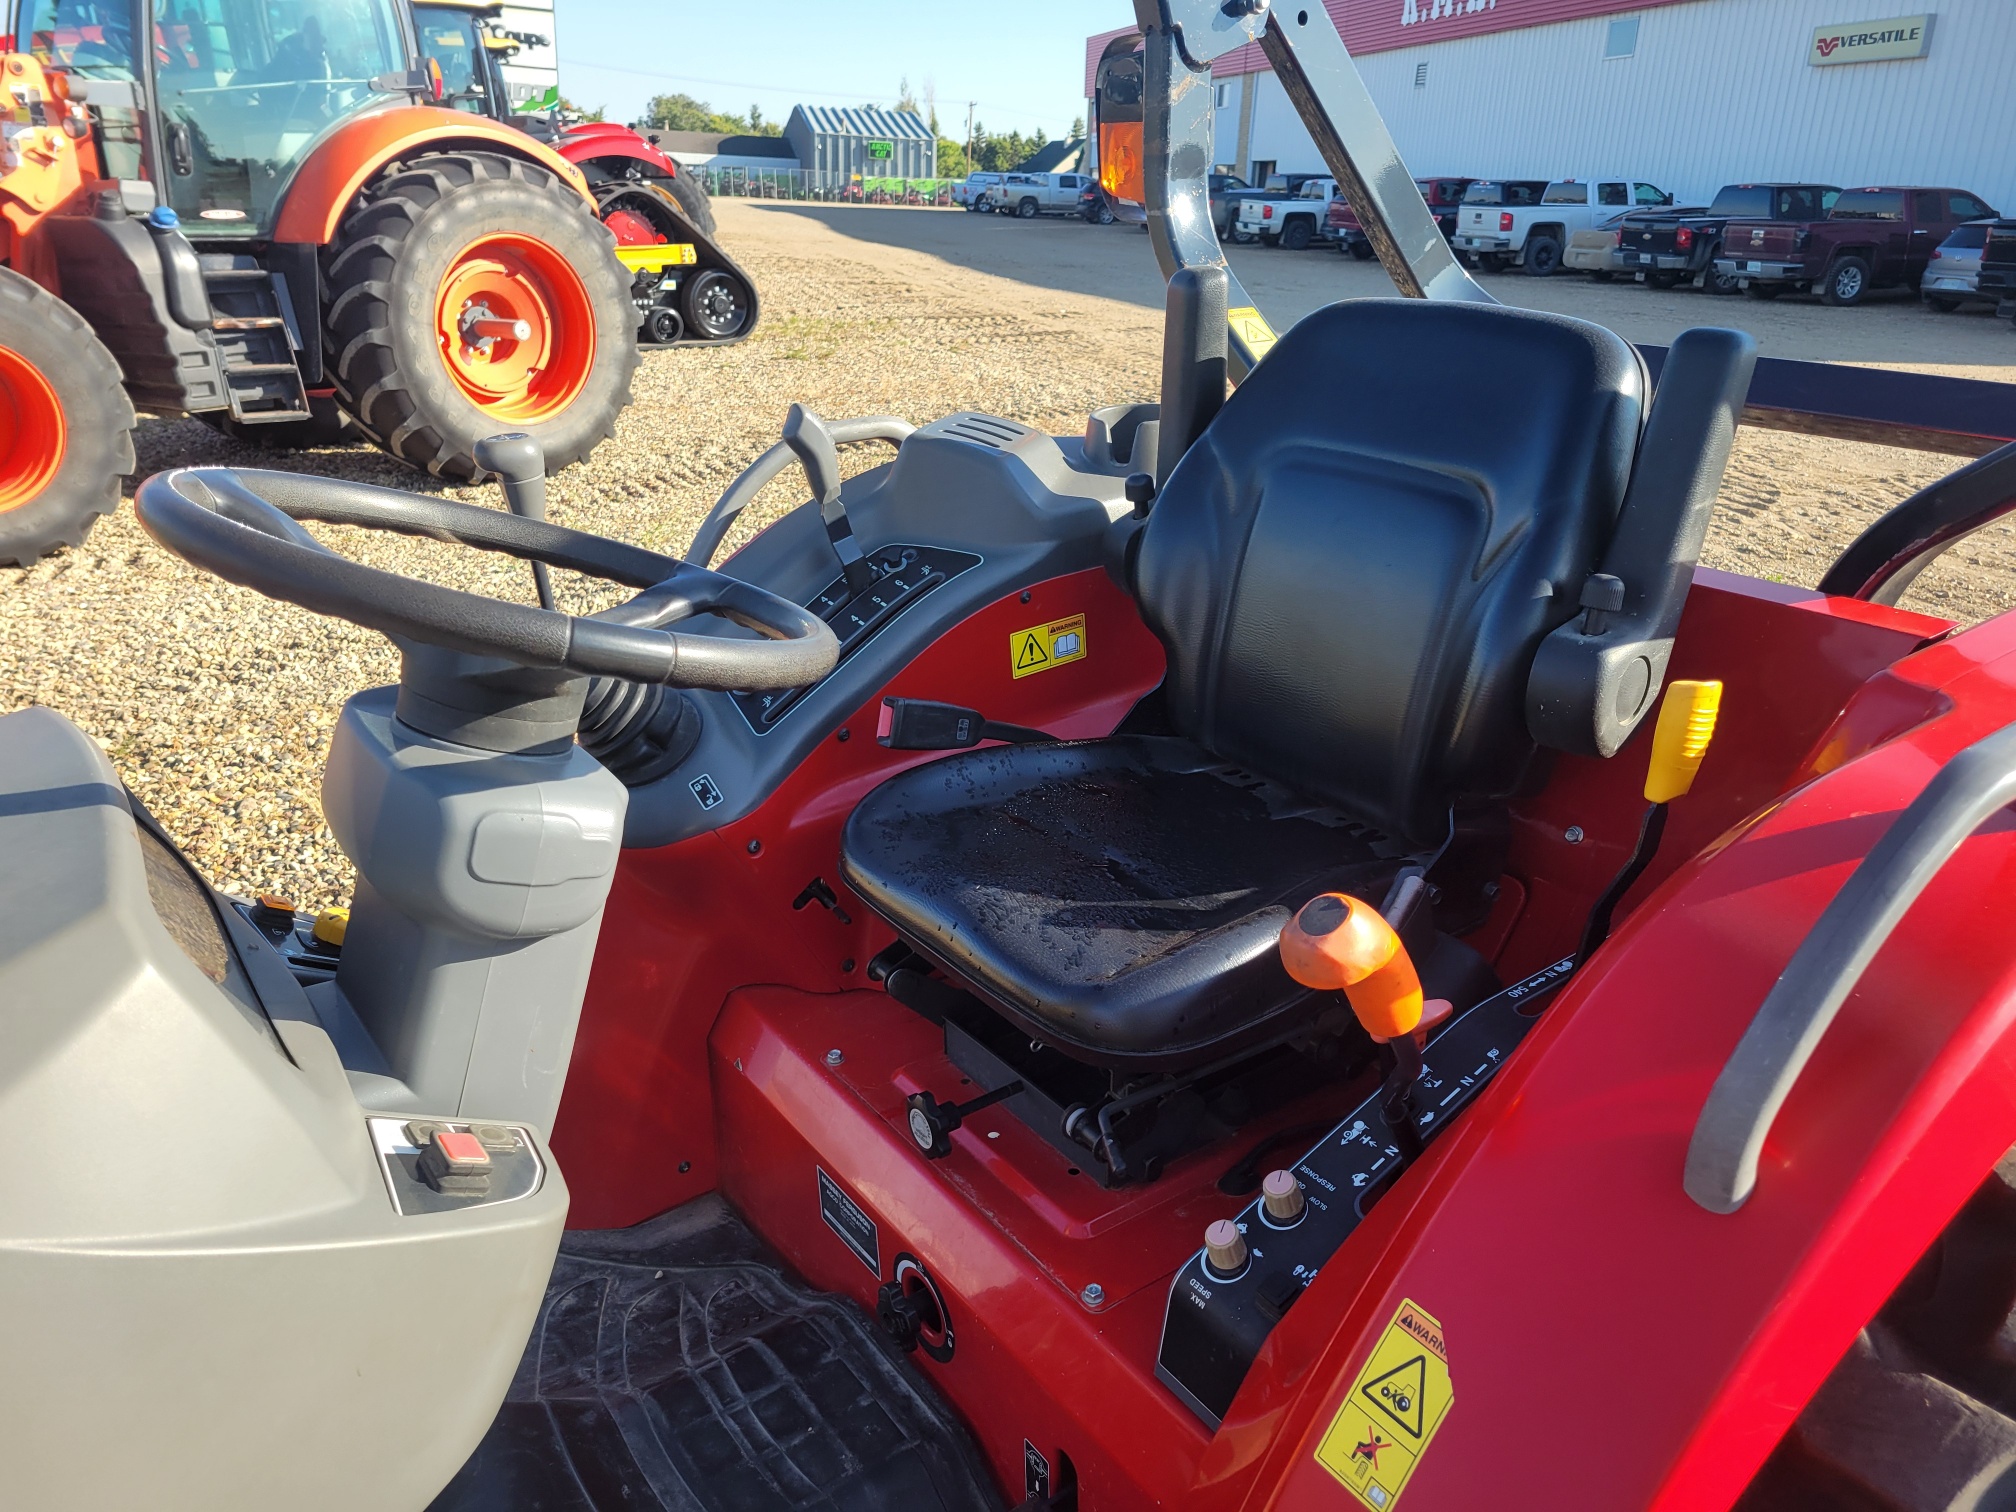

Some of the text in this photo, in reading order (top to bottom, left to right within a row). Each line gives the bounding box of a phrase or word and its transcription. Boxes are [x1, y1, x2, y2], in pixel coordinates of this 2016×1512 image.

[1840, 27, 1921, 48] VERSATILE
[872, 595, 881, 603] 5
[851, 614, 859, 622] 4
[1055, 620, 1082, 631] WARNING
[1507, 985, 1530, 998] 540
[1460, 1075, 1474, 1087] N
[1384, 1145, 1399, 1157] N
[1299, 1164, 1337, 1192] RESPONSE
[1308, 1196, 1328, 1211] SLOW
[1189, 1278, 1212, 1299] SPEED
